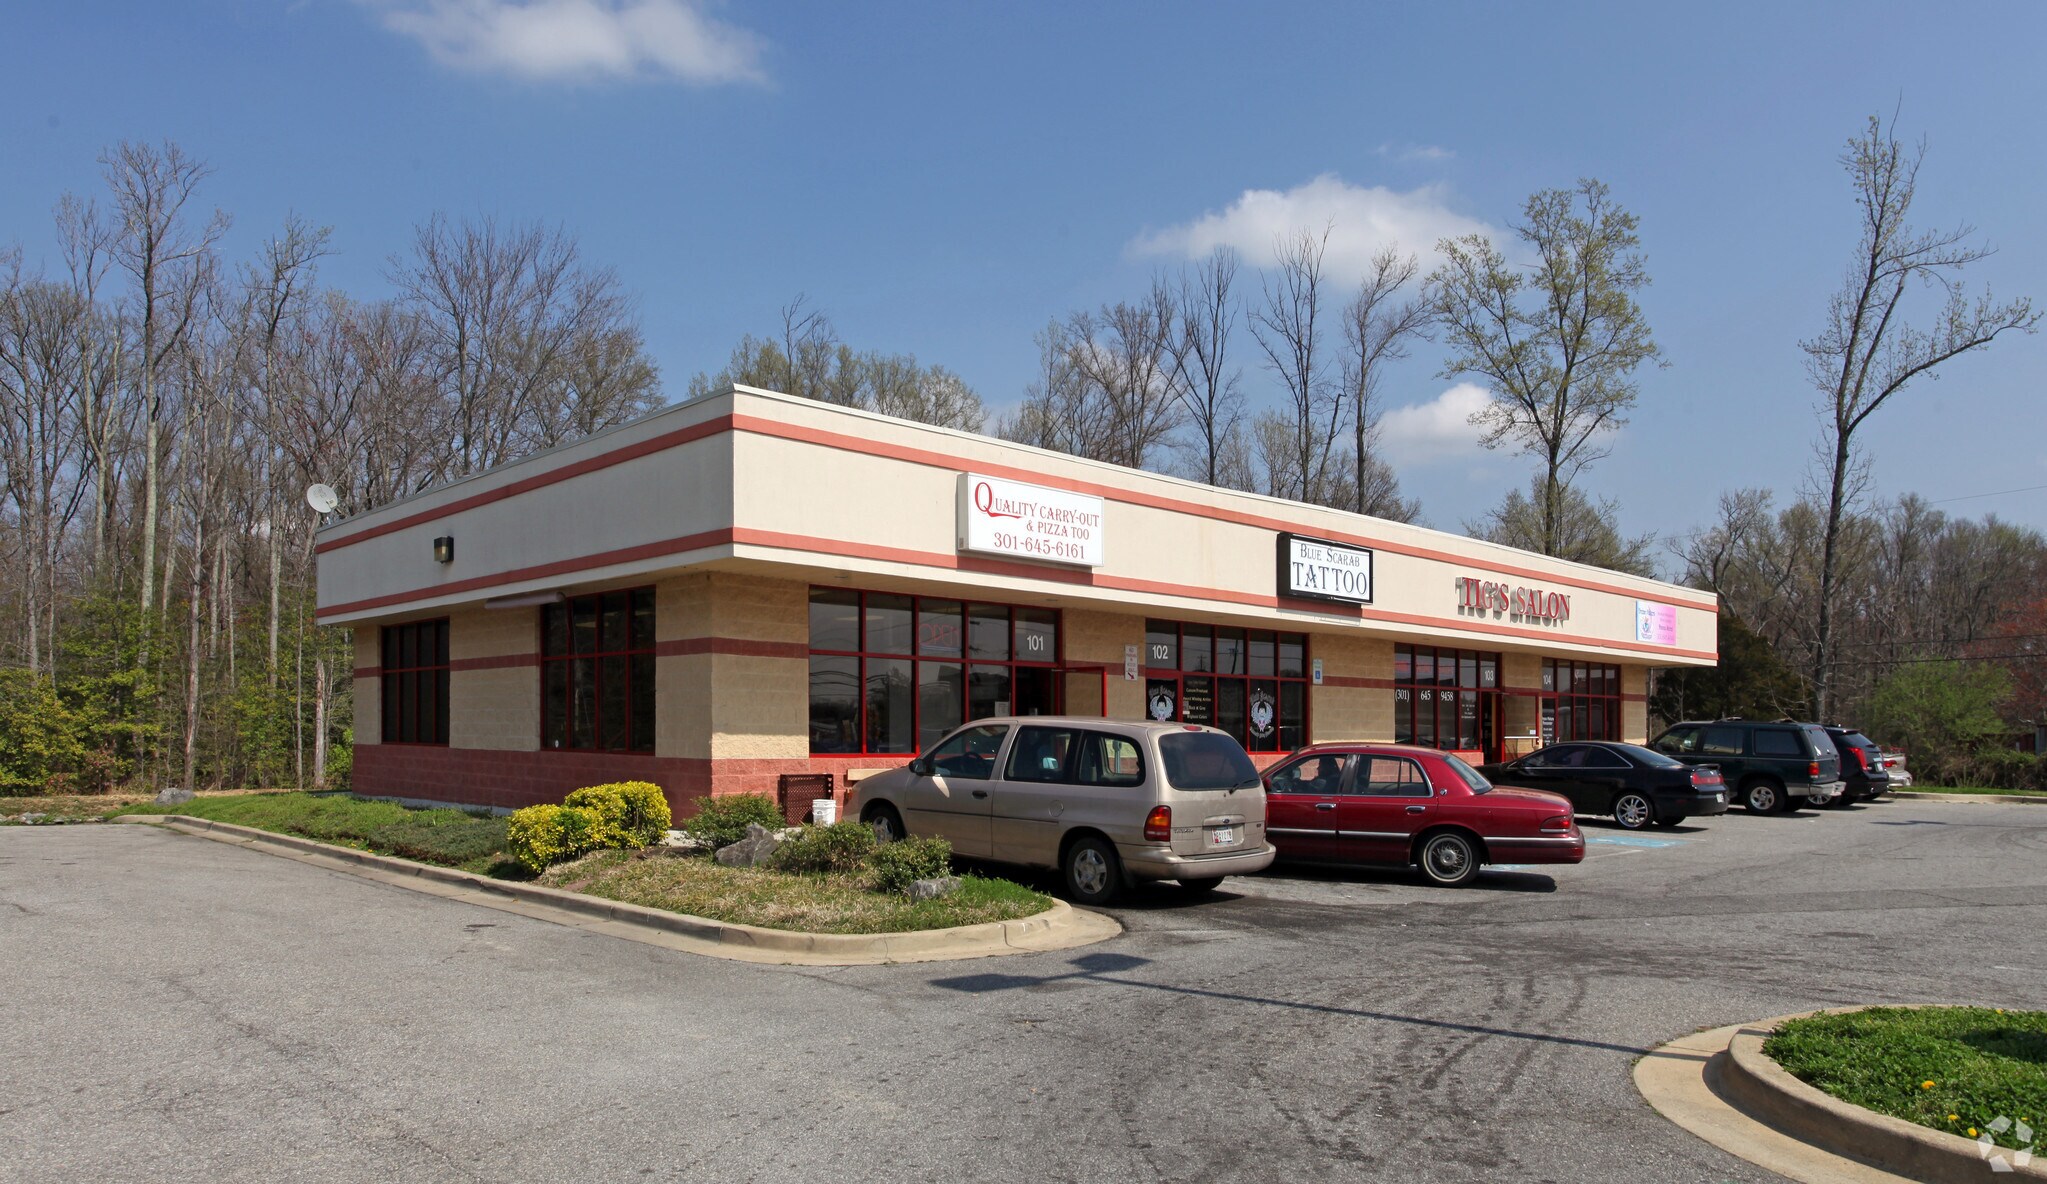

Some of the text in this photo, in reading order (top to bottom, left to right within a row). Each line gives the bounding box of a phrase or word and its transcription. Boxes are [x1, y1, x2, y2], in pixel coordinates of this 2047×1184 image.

[1039, 506, 1099, 527] CARRY-OUT
[1026, 520, 1090, 540] & PIZZA TOO
[994, 532, 1085, 560] 301-645-6161
[1300, 543, 1360, 568] BLUE SCARAB
[1292, 561, 1367, 596] TATTOO
[1462, 576, 1571, 621] TIG'S SALON
[1026, 635, 1044, 651] 101
[1152, 644, 1169, 660] 102
[1484, 670, 1495, 681] 103
[1395, 689, 1454, 703] (301) 645 9458
